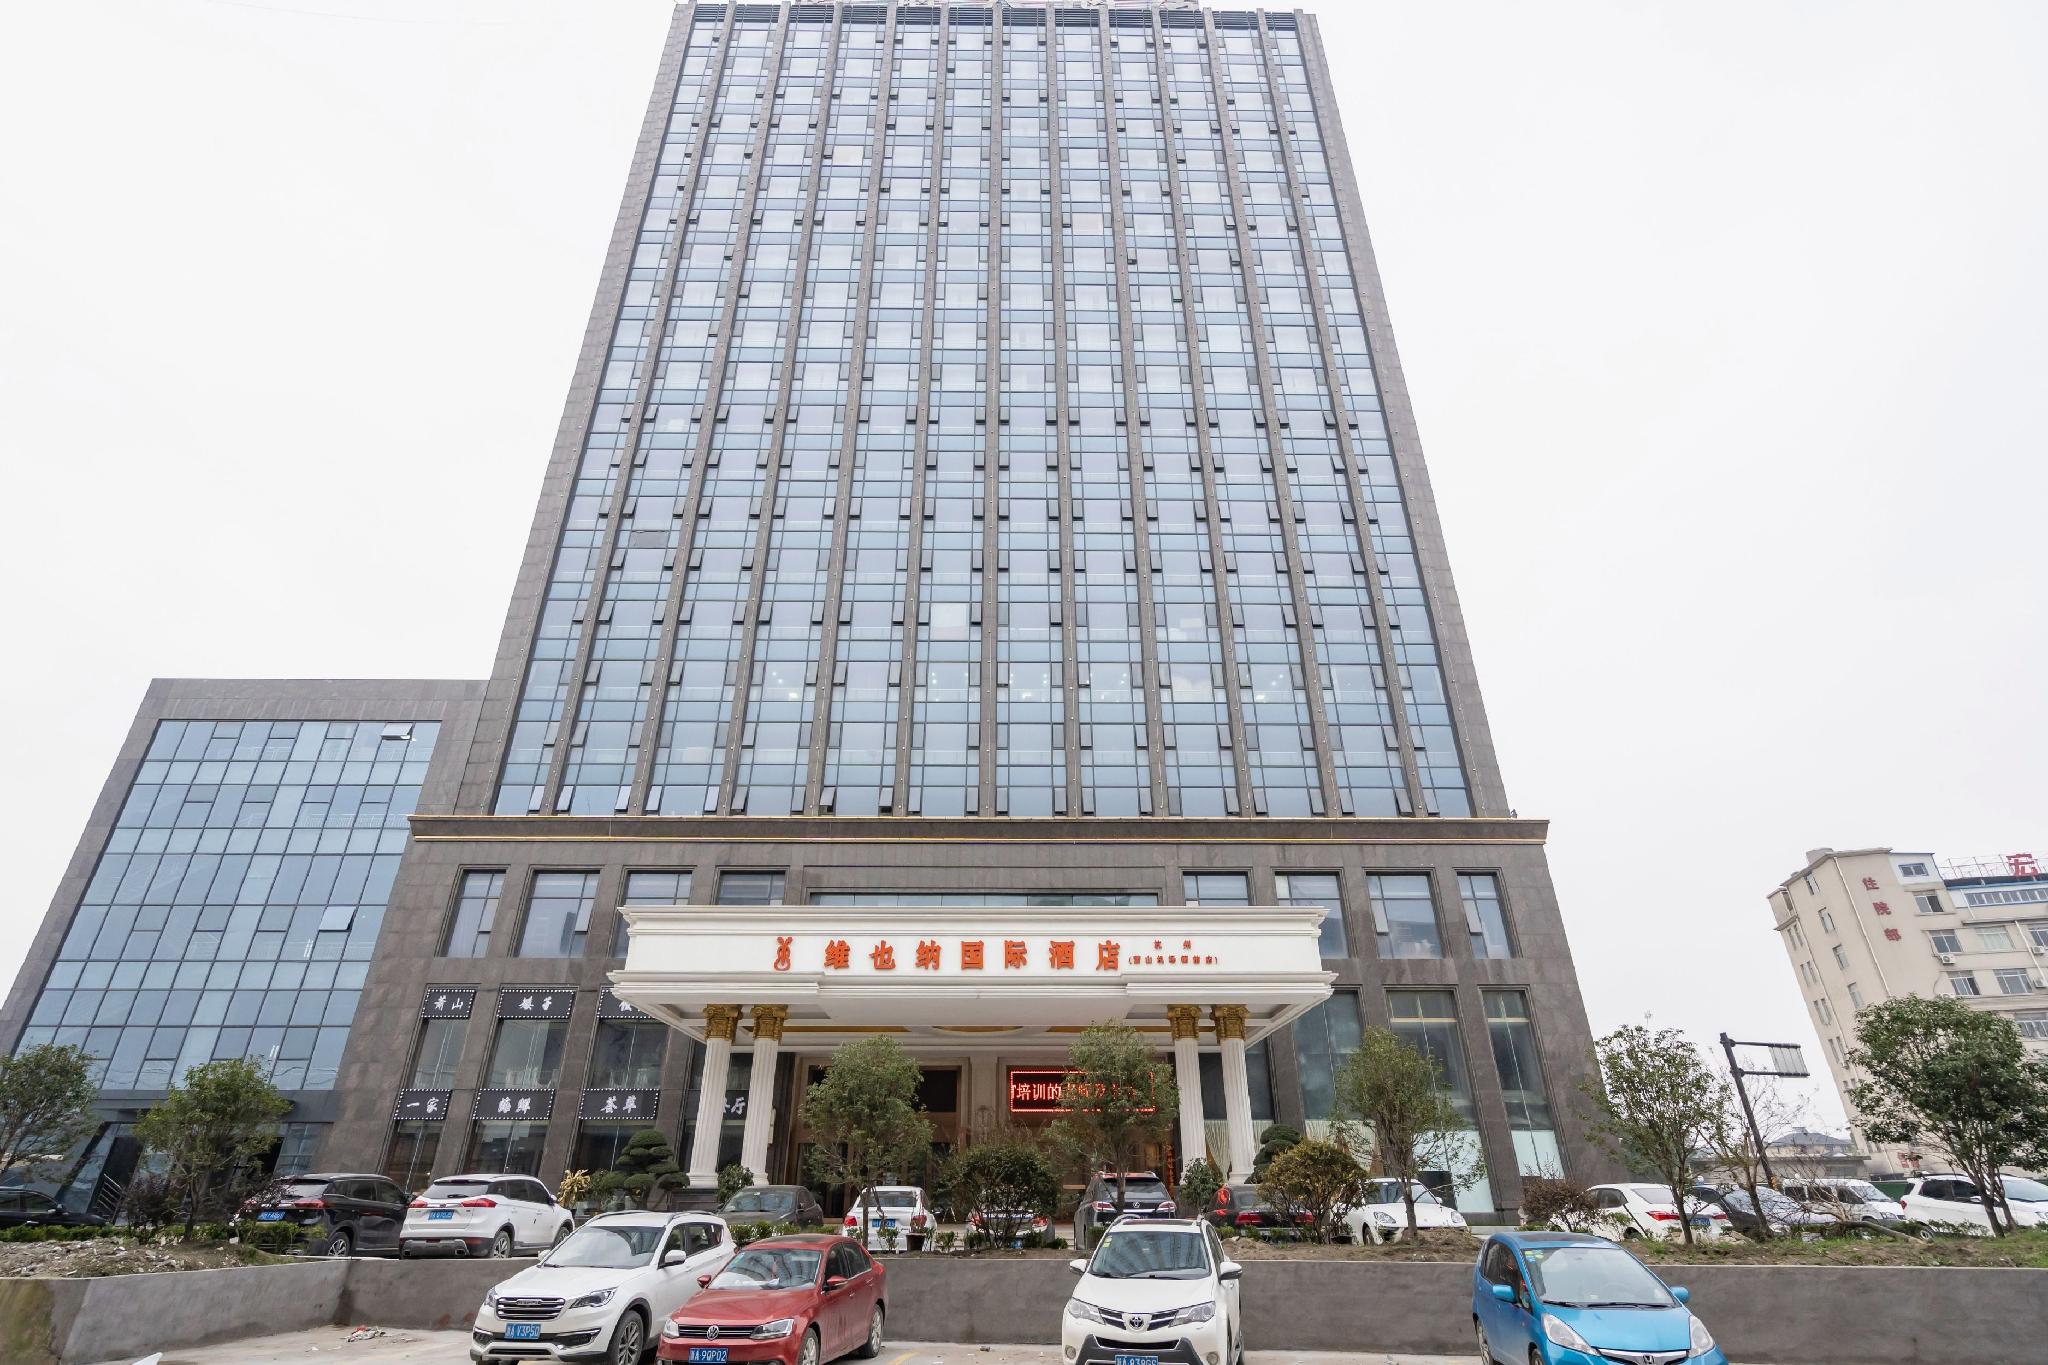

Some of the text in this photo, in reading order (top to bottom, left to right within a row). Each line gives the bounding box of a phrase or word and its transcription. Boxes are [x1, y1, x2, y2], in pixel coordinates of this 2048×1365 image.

[1862, 877, 1901, 941] 住院部
[824, 939, 1120, 970] 维也纳国际酒店
